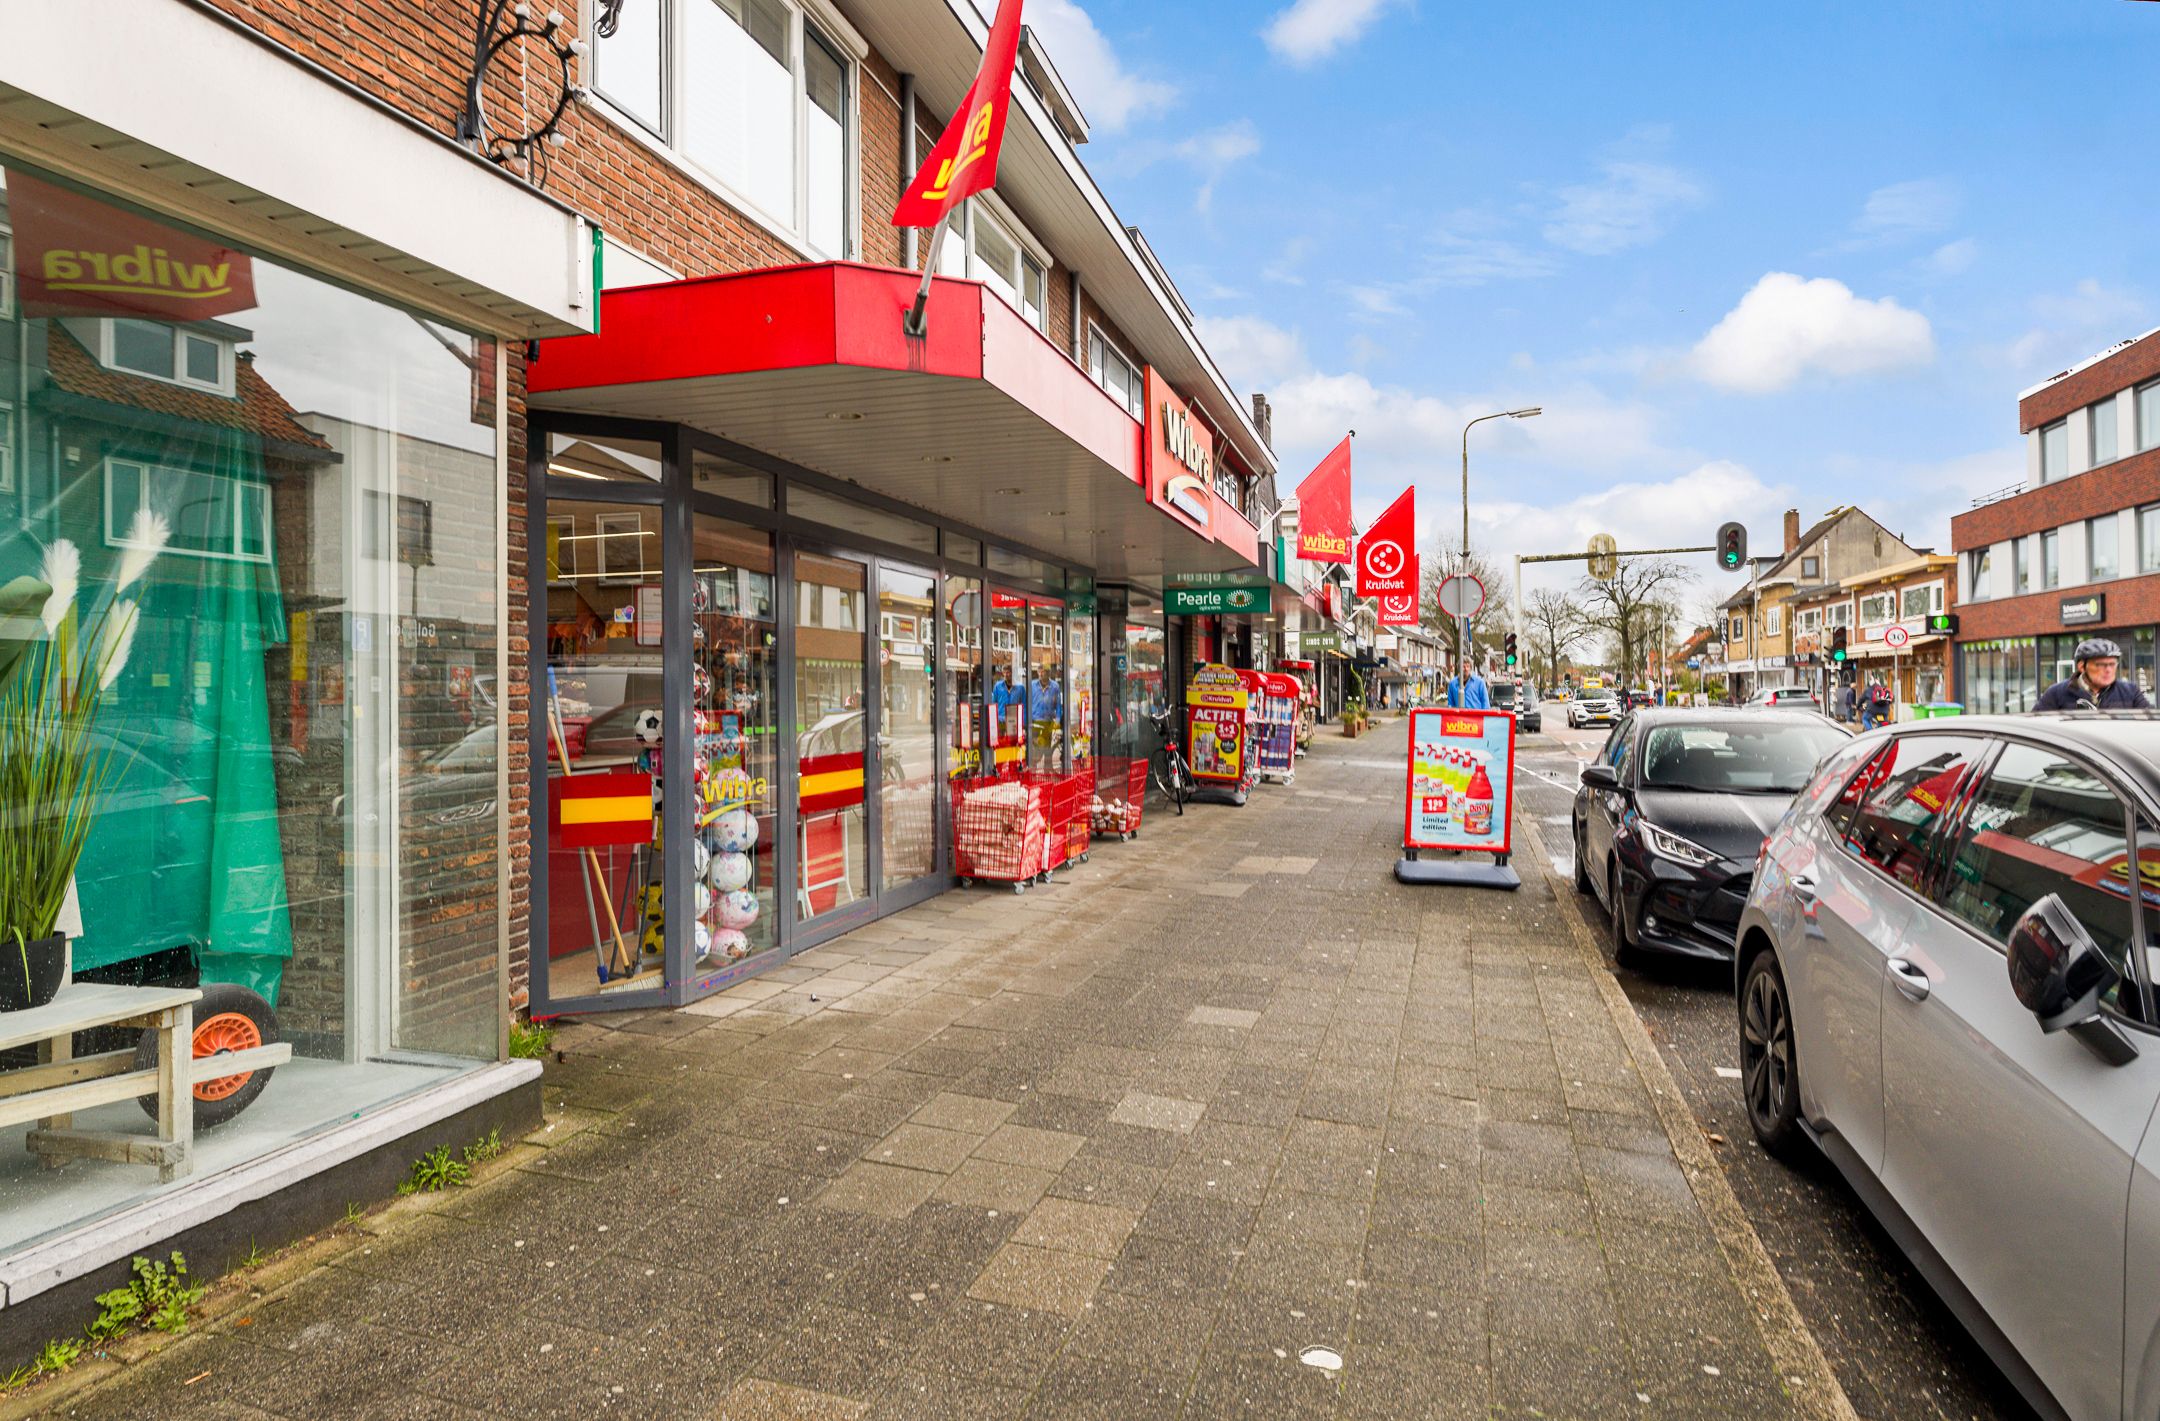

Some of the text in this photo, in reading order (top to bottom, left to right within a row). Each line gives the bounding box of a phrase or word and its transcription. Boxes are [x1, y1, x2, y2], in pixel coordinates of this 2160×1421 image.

[1163, 400, 1211, 486] Wibra
[1303, 532, 1346, 554] wibra
[1365, 579, 1404, 589] Kruidvat
[1177, 591, 1221, 606] Pearle
[1195, 708, 1238, 723] ACTIE!
[1446, 721, 1479, 732] wibra
[701, 770, 768, 804] Wibra
[1422, 816, 1449, 824] Limited
